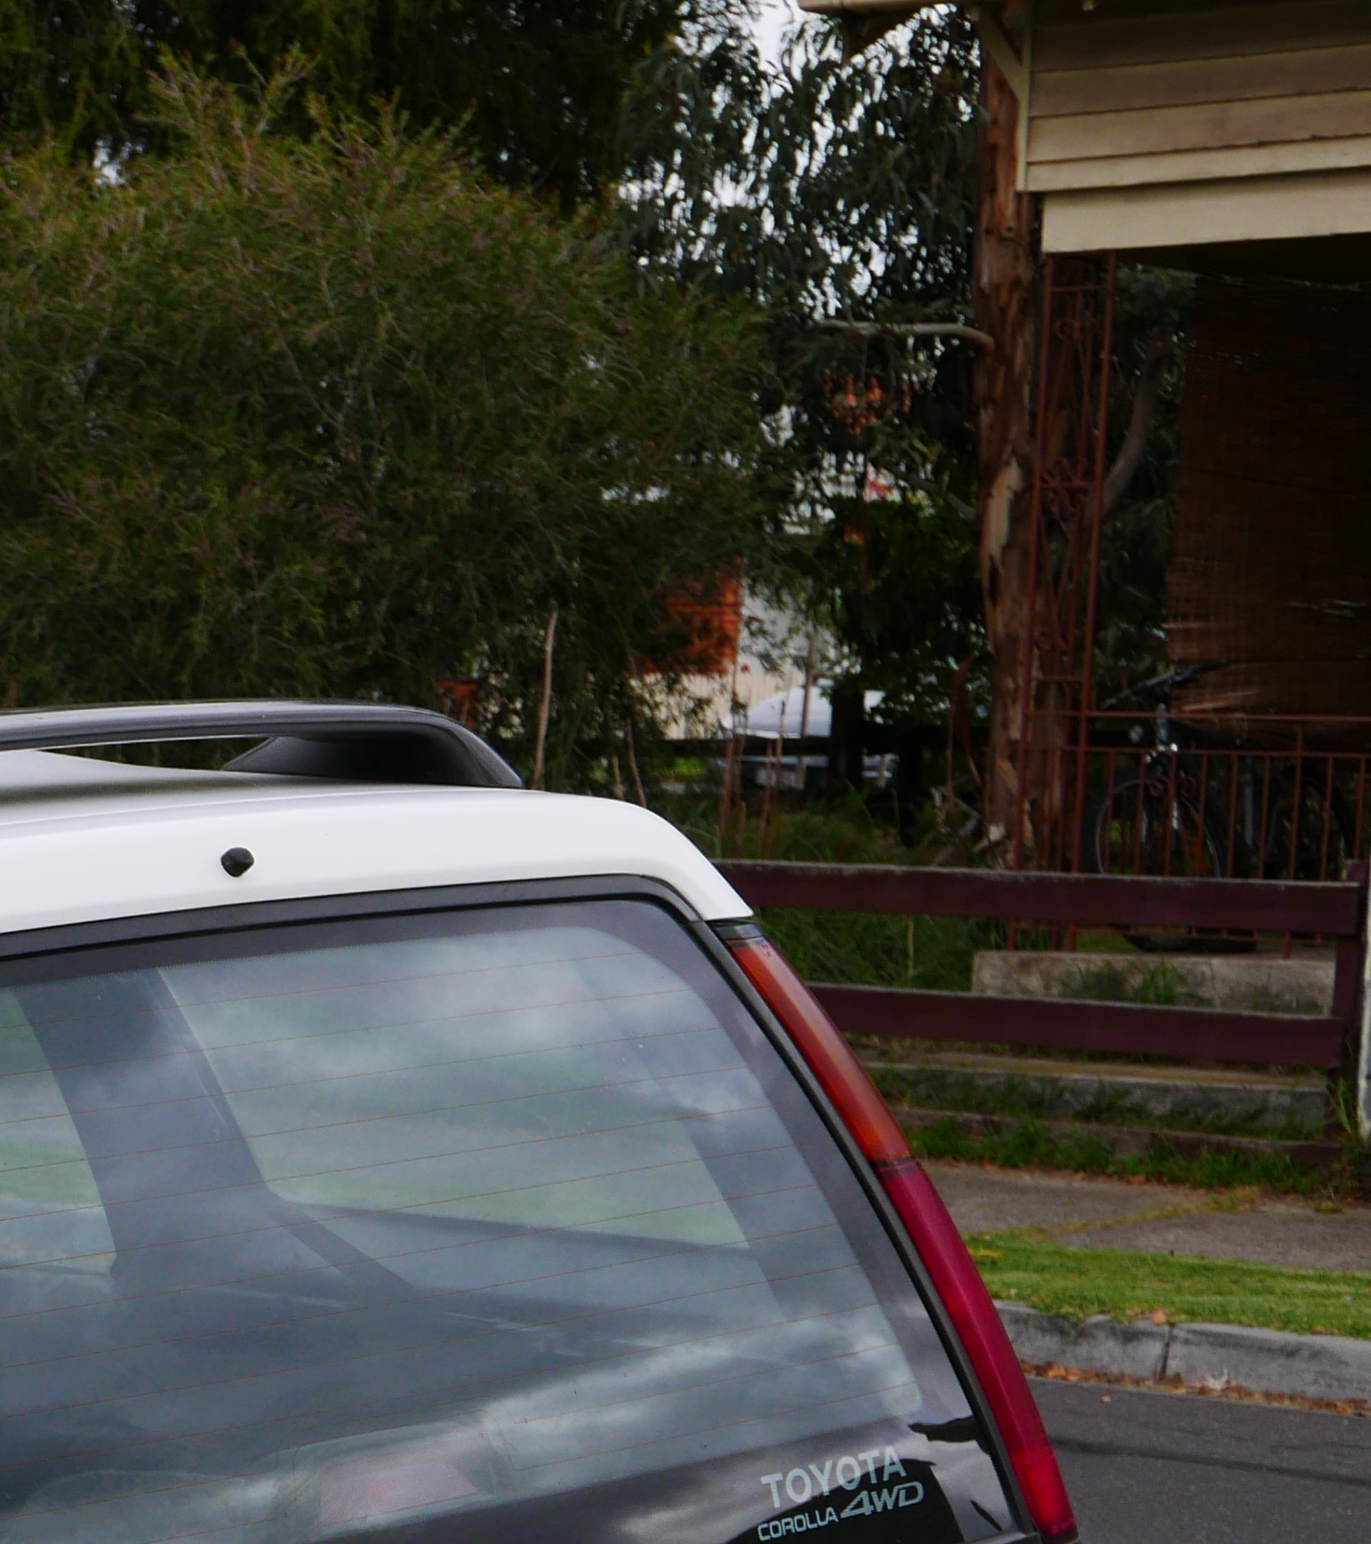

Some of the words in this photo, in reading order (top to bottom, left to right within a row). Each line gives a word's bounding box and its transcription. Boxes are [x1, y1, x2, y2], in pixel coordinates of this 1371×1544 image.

[761, 1445, 907, 1508] TOYOTA
[758, 1506, 839, 1542] COROLLA
[840, 1481, 924, 1519] 4WD
